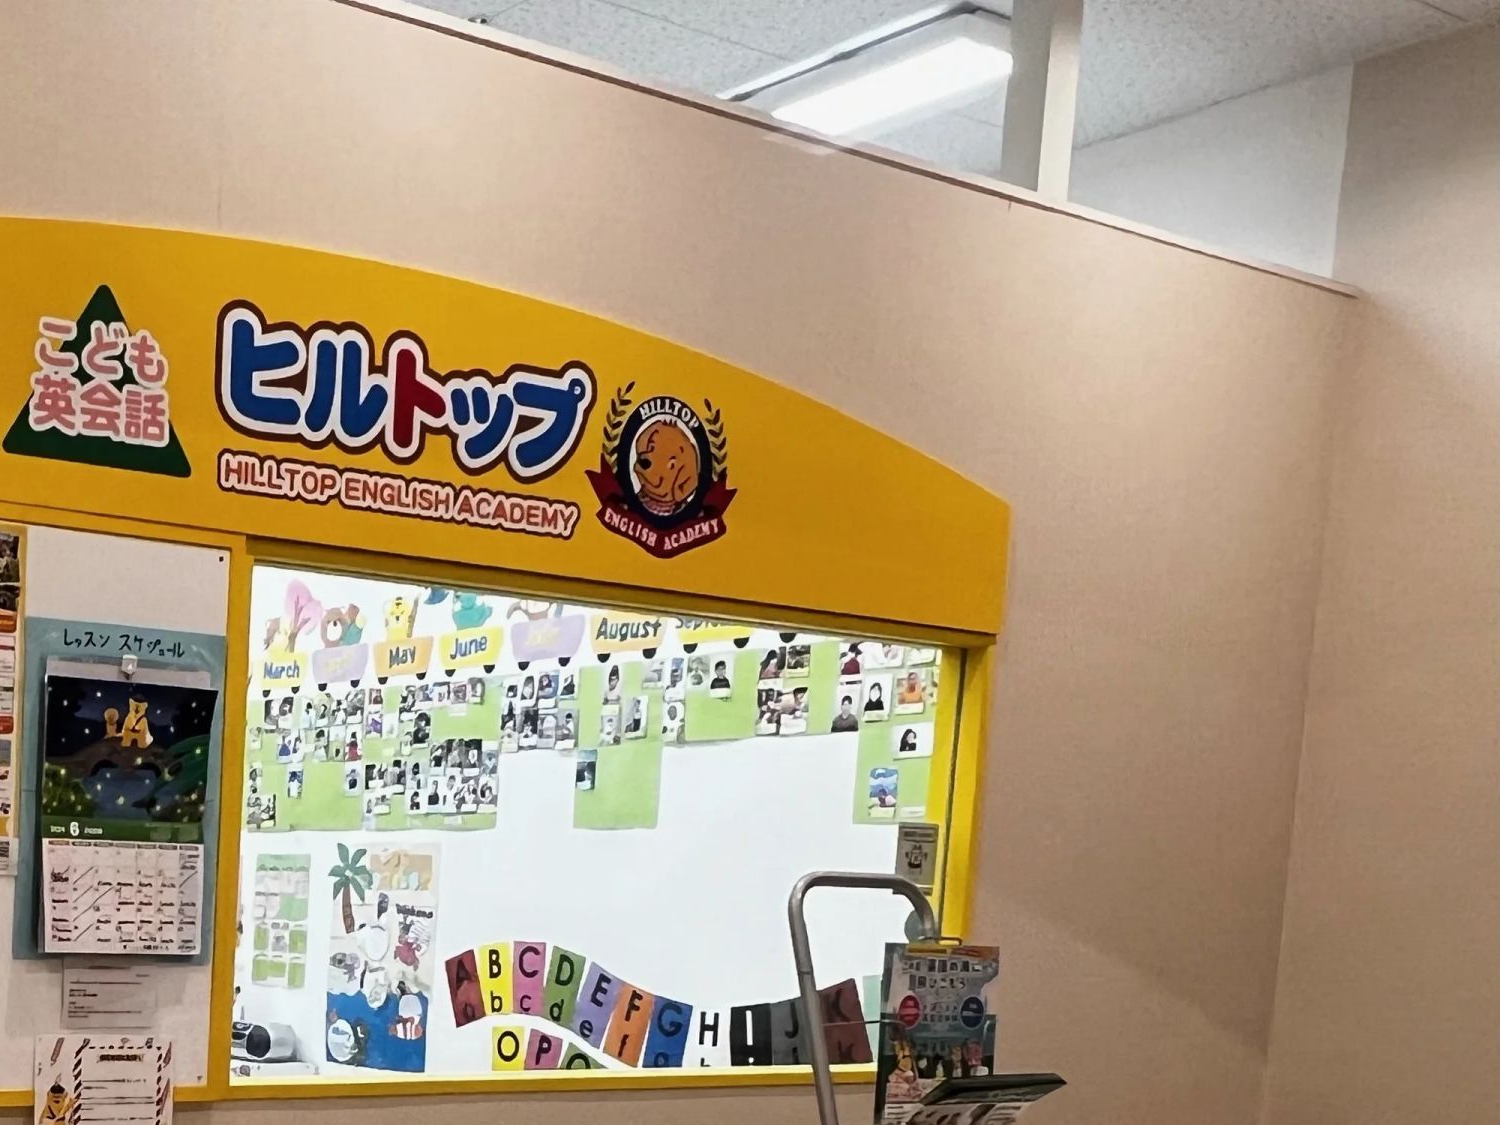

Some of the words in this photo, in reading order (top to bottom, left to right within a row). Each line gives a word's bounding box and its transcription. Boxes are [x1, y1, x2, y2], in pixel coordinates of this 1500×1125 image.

[33, 317, 168, 385] こども
[224, 306, 592, 477] ヒルトップ
[30, 374, 169, 447] 英会話
[638, 398, 700, 430] HILLTOP
[219, 451, 338, 503] HILLTOP
[344, 479, 453, 520] ENGLISH
[456, 489, 578, 538] ACADEMY
[603, 507, 657, 547] ENGLISH
[663, 518, 720, 550] ACADEMY
[63, 628, 111, 649] レッスン
[118, 633, 186, 659] スケジュール
[449, 634, 488, 660] June
[595, 616, 663, 642] August
[263, 662, 301, 680] March
[388, 644, 417, 667] May
[488, 948, 502, 979] B
[518, 945, 541, 978] C
[554, 953, 575, 986] D
[590, 972, 612, 1008] E
[624, 989, 644, 1022] F
[656, 1002, 684, 1037] G
[698, 1011, 720, 1047] H
